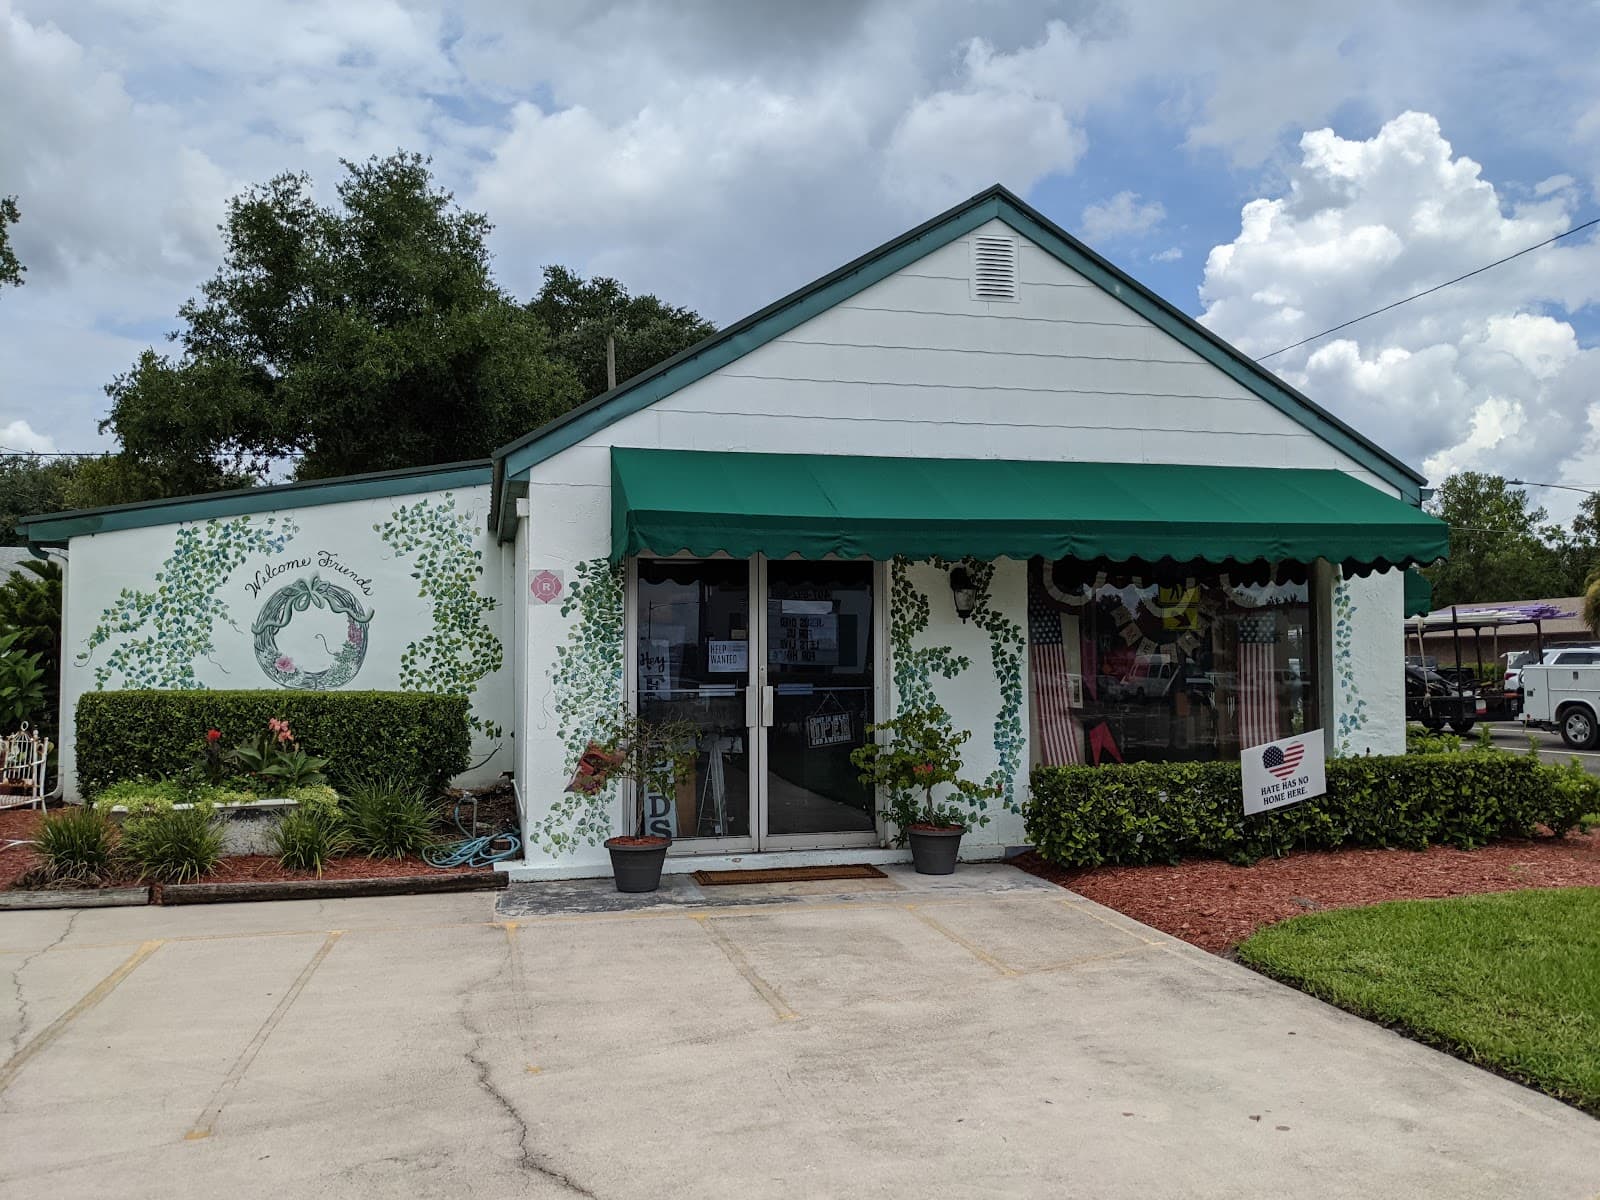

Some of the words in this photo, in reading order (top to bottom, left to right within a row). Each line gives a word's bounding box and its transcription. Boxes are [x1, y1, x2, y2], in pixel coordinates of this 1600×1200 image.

[245, 556, 312, 599] Welcome
[317, 550, 374, 597] Friends
[542, 582, 551, 591] R
[639, 651, 665, 673] Hey
[710, 654, 737, 665] WANTED
[810, 718, 850, 738] OPEN
[1261, 784, 1281, 796] HATE
[1282, 779, 1297, 790] HAS
[1298, 775, 1309, 786] NO
[1263, 793, 1286, 806] HOME
